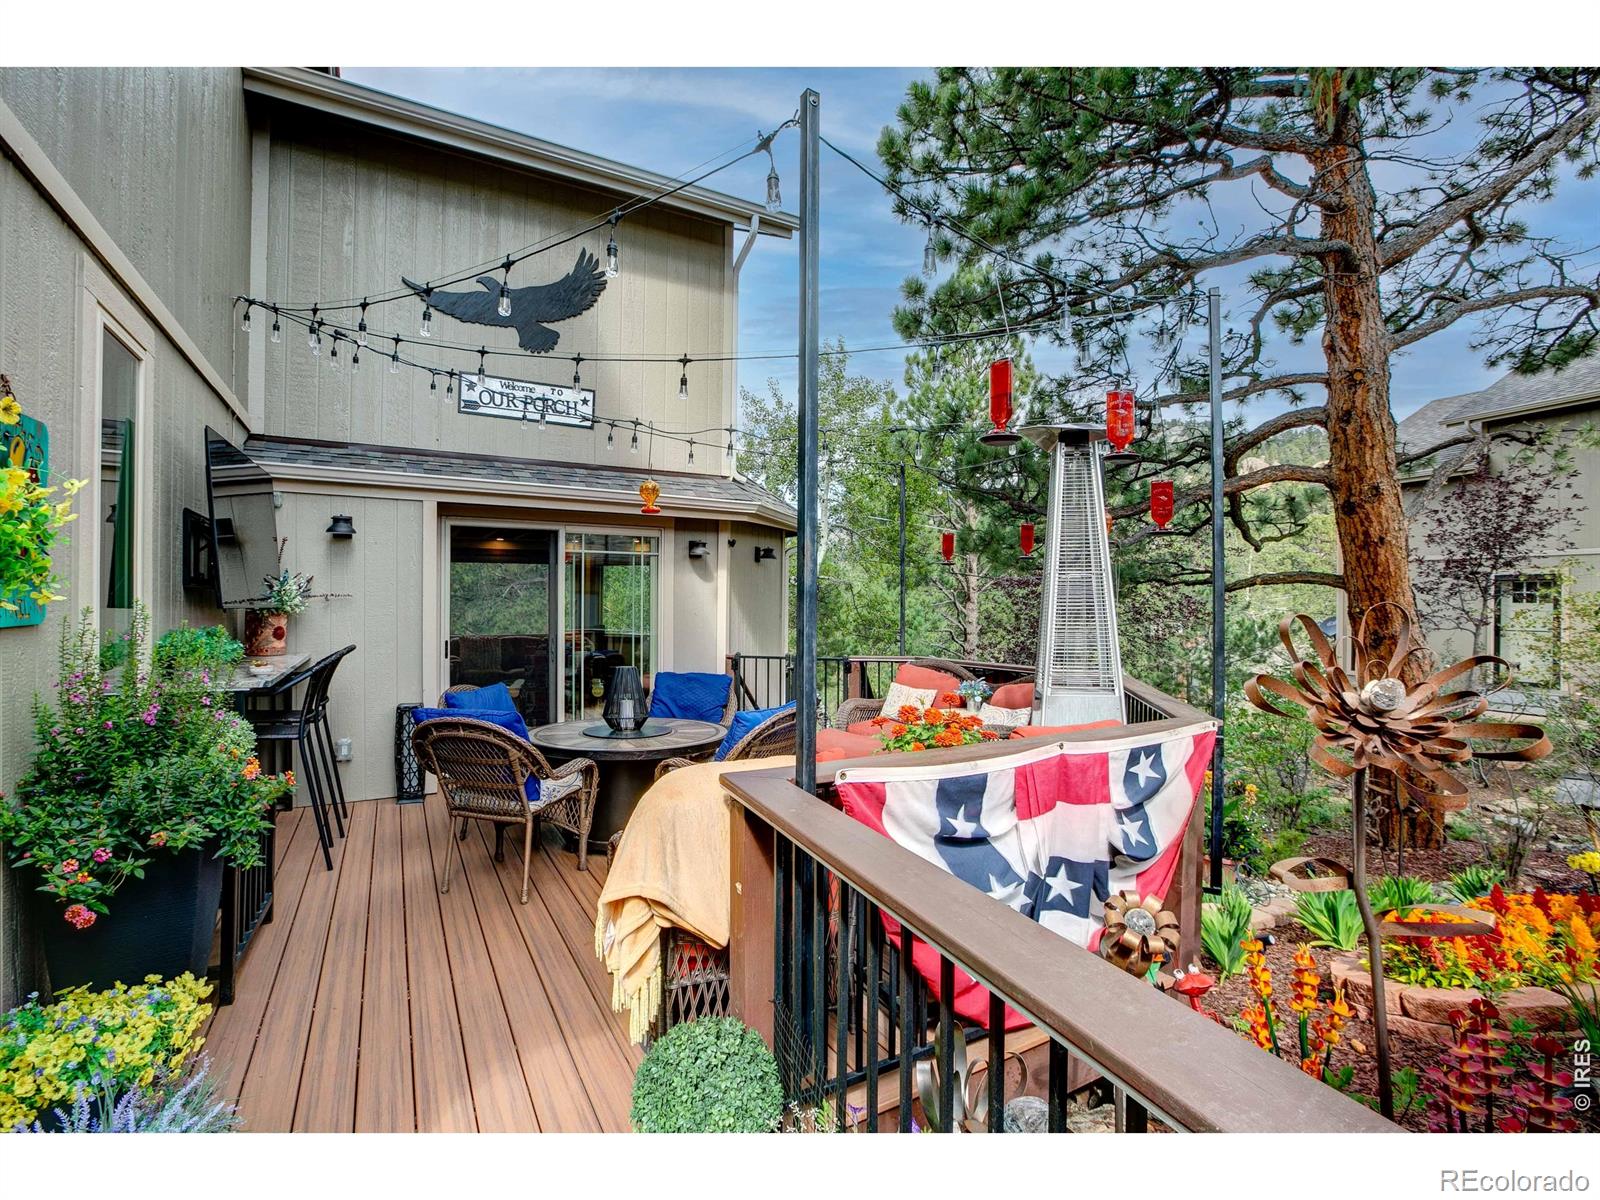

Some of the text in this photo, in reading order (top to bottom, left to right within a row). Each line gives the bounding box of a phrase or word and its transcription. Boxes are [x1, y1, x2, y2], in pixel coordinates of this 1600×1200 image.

[500, 381, 564, 397] Welcome TO
[479, 390, 578, 416] OUR PORCH
